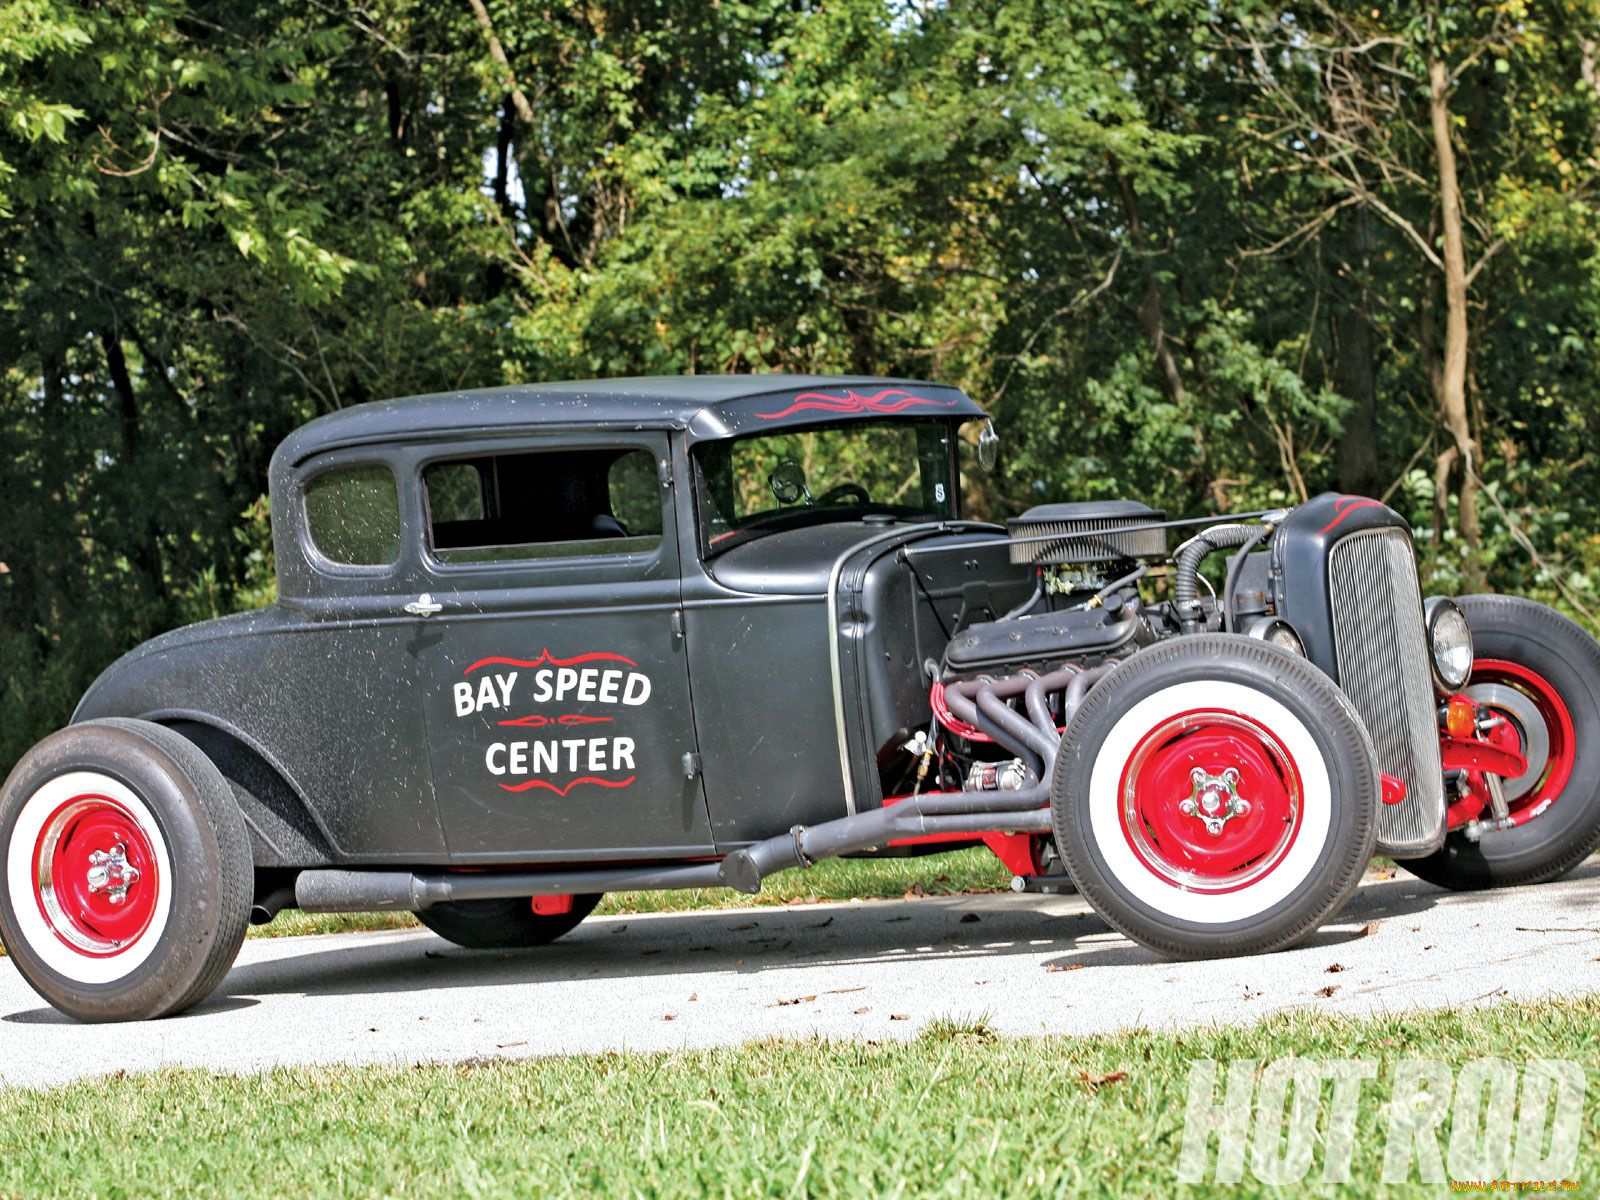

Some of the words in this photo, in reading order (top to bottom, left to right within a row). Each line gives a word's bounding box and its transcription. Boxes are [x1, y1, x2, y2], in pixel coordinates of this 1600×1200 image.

[453, 671, 518, 717] BAY
[533, 668, 651, 706] SPEED
[485, 737, 635, 775] CENTER
